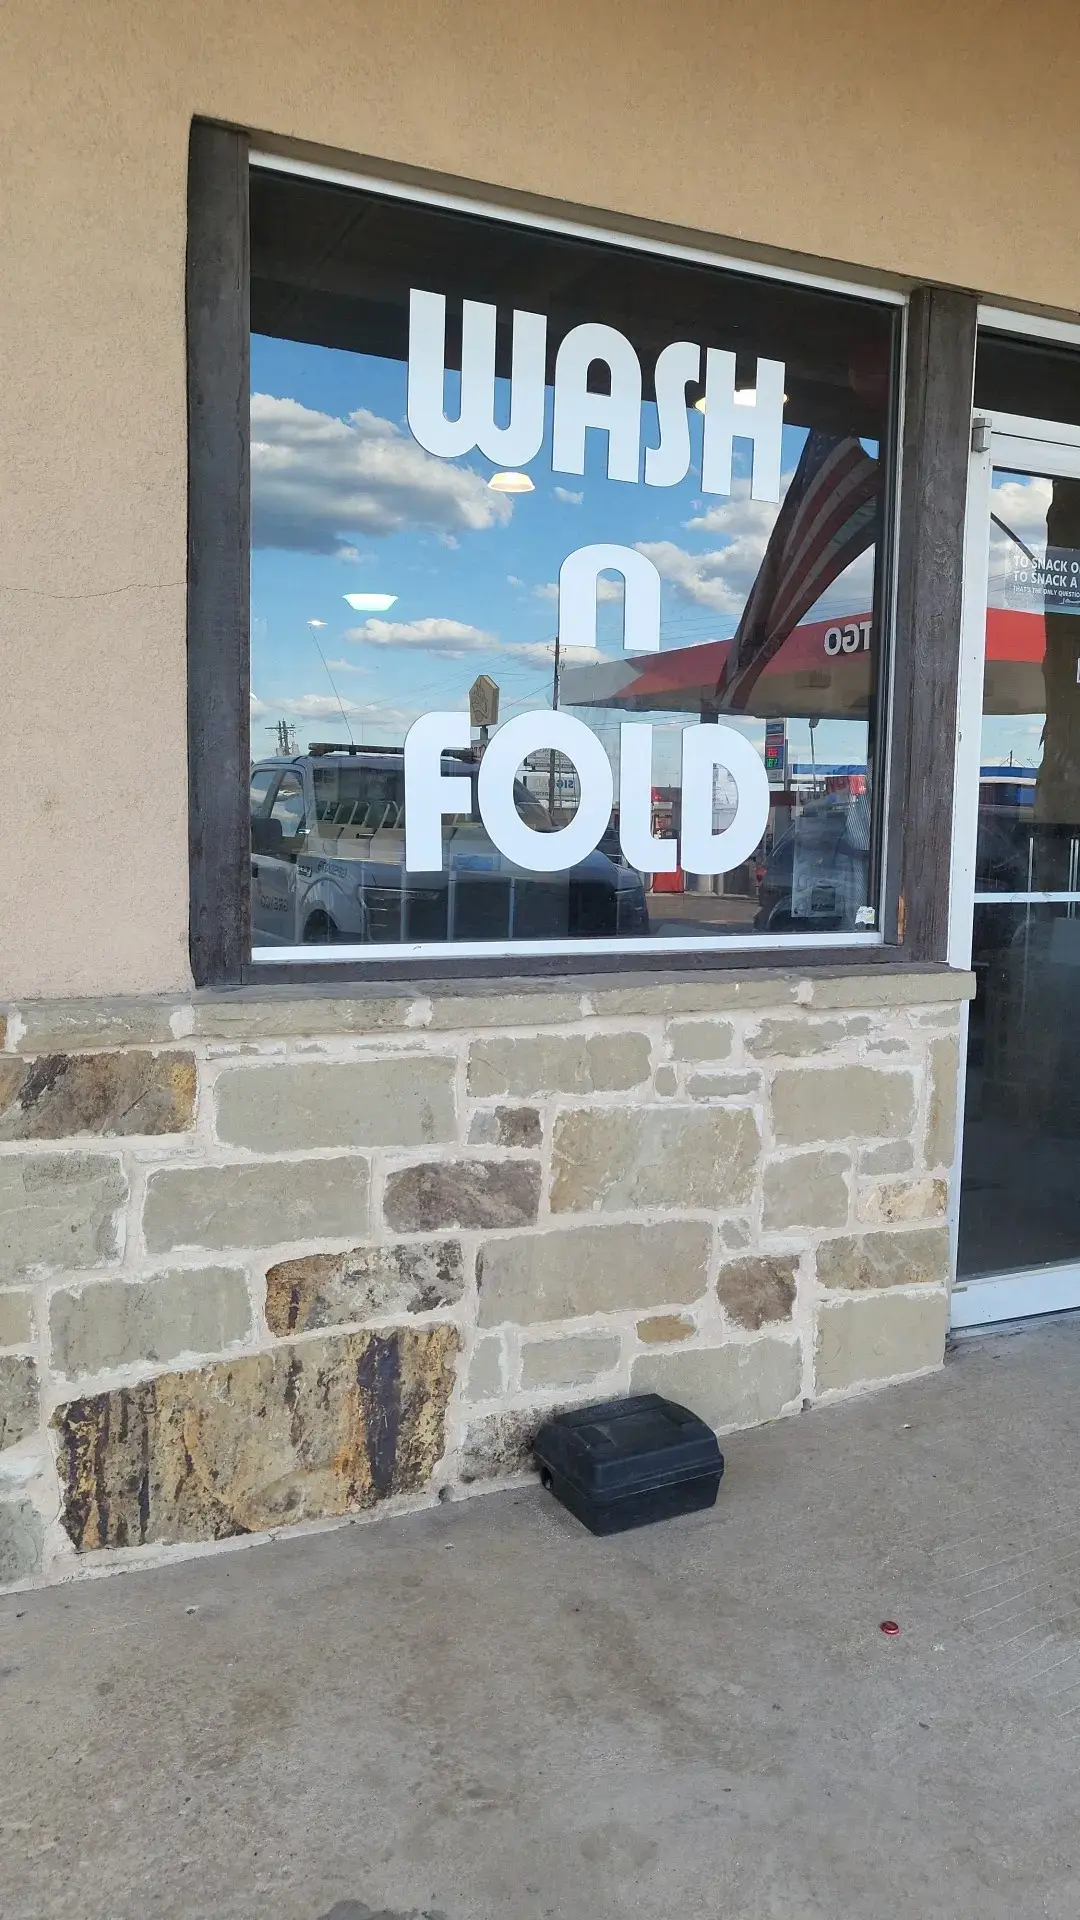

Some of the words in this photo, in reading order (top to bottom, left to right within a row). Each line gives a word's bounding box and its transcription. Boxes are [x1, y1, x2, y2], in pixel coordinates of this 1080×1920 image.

[407, 288, 785, 504] WASH
[1013, 555, 1029, 568] TO
[1031, 557, 1068, 573] SNACK
[1070, 561, 1080, 574] O
[1013, 570, 1028, 583] TO
[1031, 572, 1067, 587] SNACK
[1043, 588, 1058, 596] ONLY
[404, 709, 770, 875] FOLD
